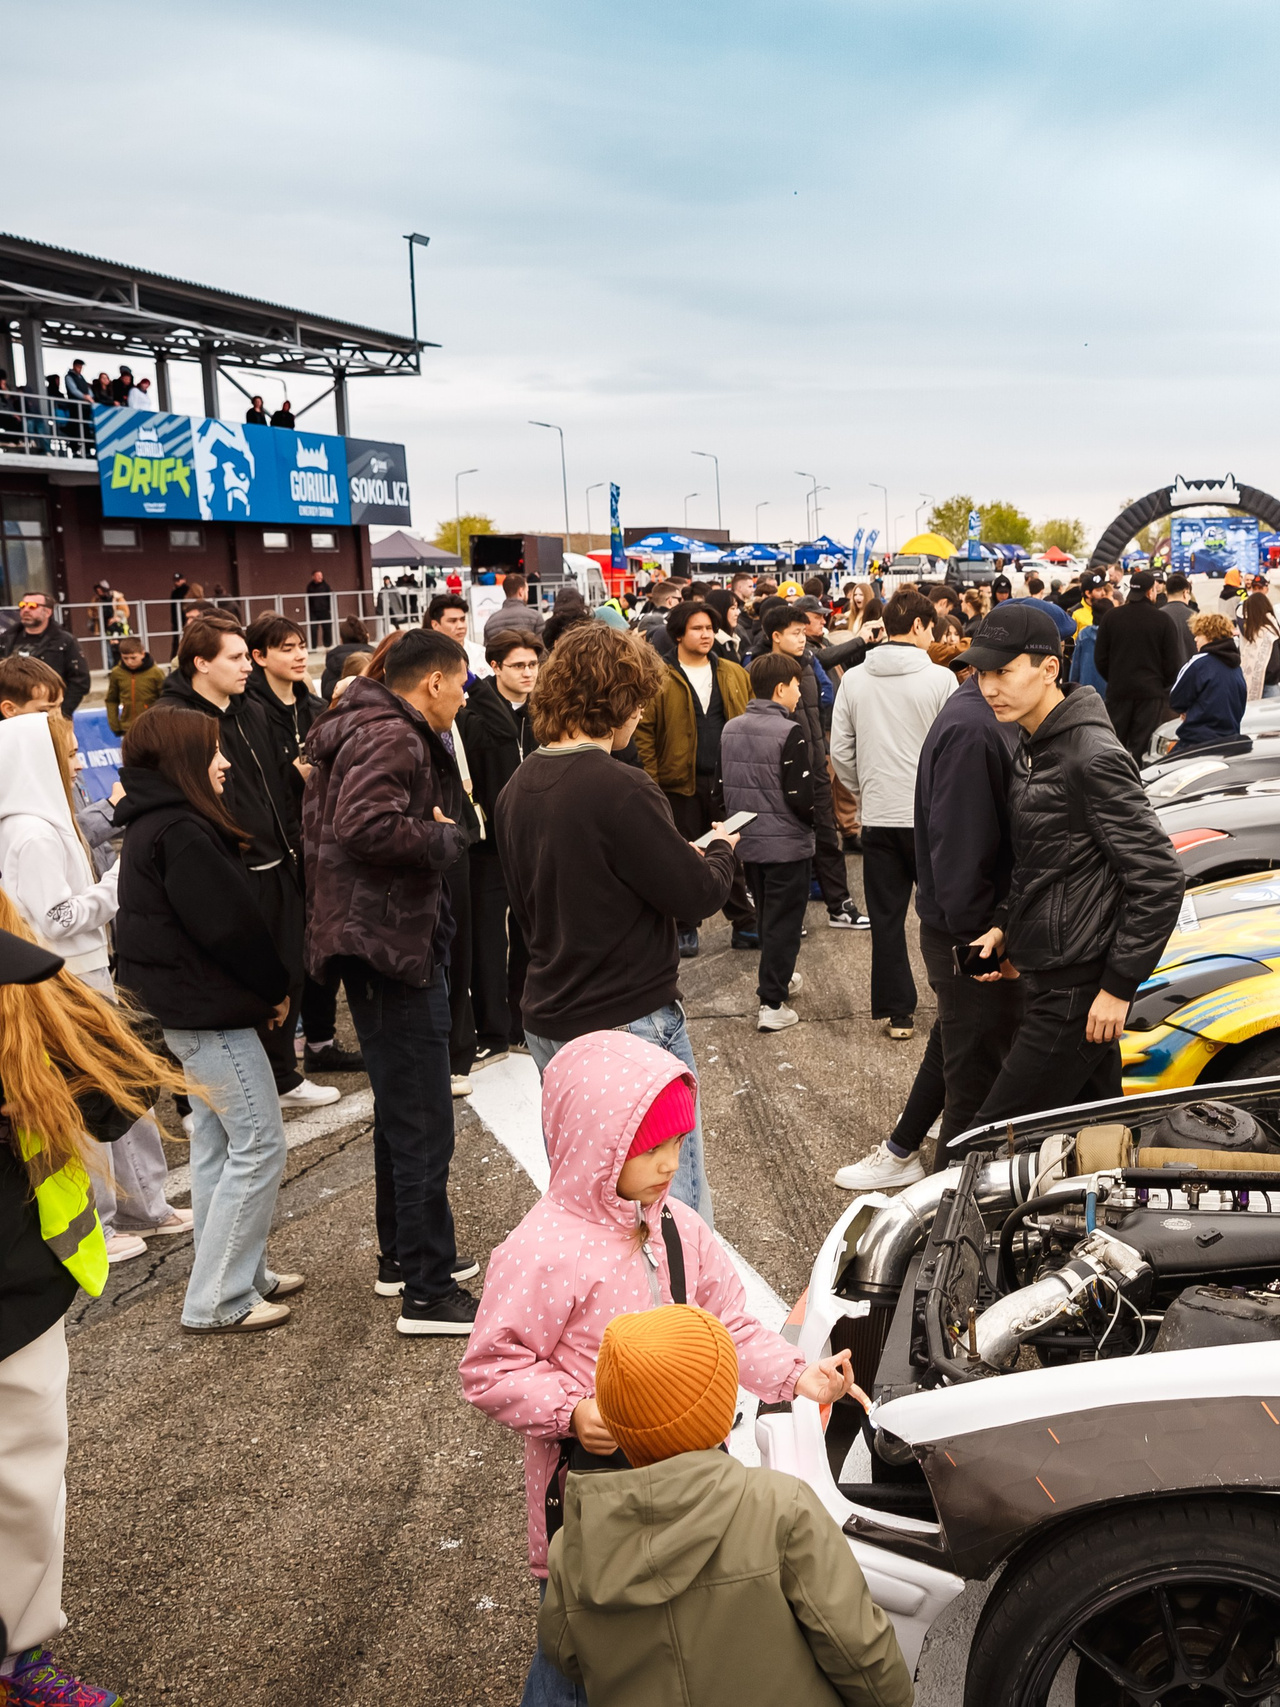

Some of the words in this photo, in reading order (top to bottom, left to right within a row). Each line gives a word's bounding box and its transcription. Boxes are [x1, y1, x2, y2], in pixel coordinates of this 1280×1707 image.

[111, 453, 191, 498] DRIFT
[290, 470, 339, 504] GORILLA
[350, 477, 409, 507] SOKOL.KZ
